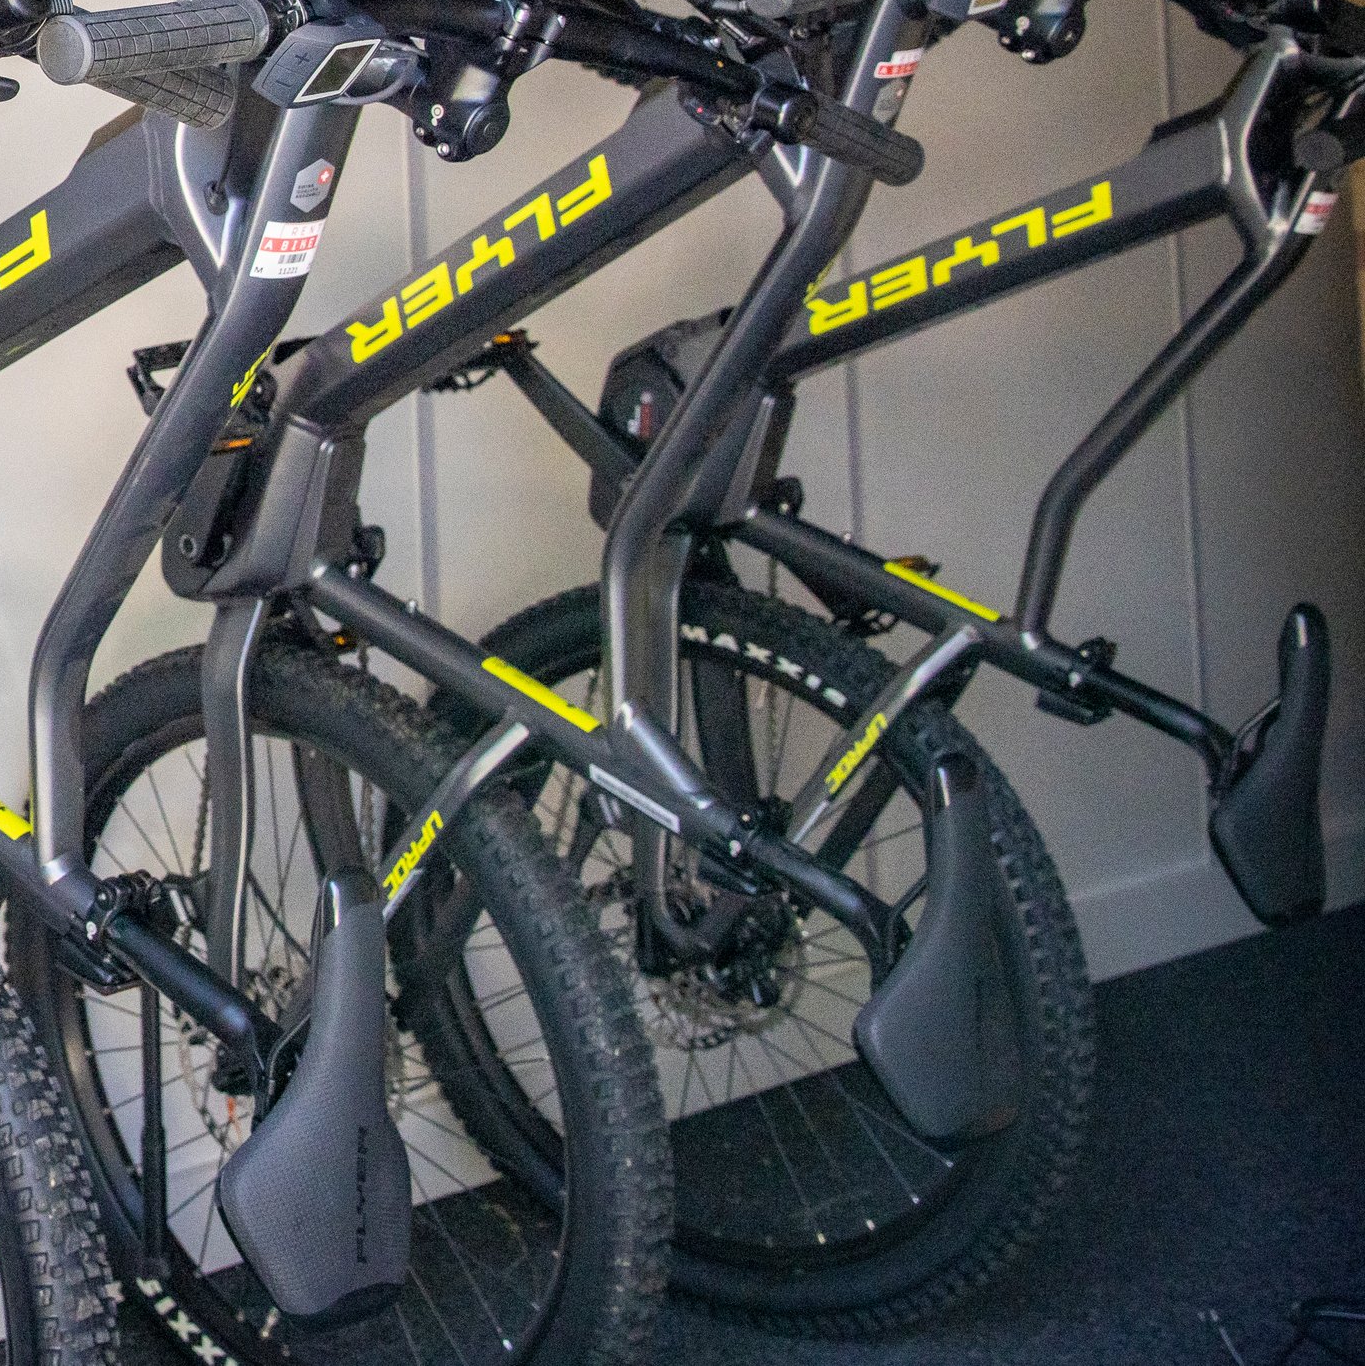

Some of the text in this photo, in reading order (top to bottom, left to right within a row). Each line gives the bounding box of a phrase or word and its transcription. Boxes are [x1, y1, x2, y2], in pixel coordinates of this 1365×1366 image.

[264, 236, 316, 251] A BIKE
[345, 154, 613, 364] FLYER
[806, 181, 1112, 336] FLYER
[681, 623, 848, 709] MAXXIS
[824, 713, 888, 794] UPROC
[382, 810, 444, 900] UPROC
